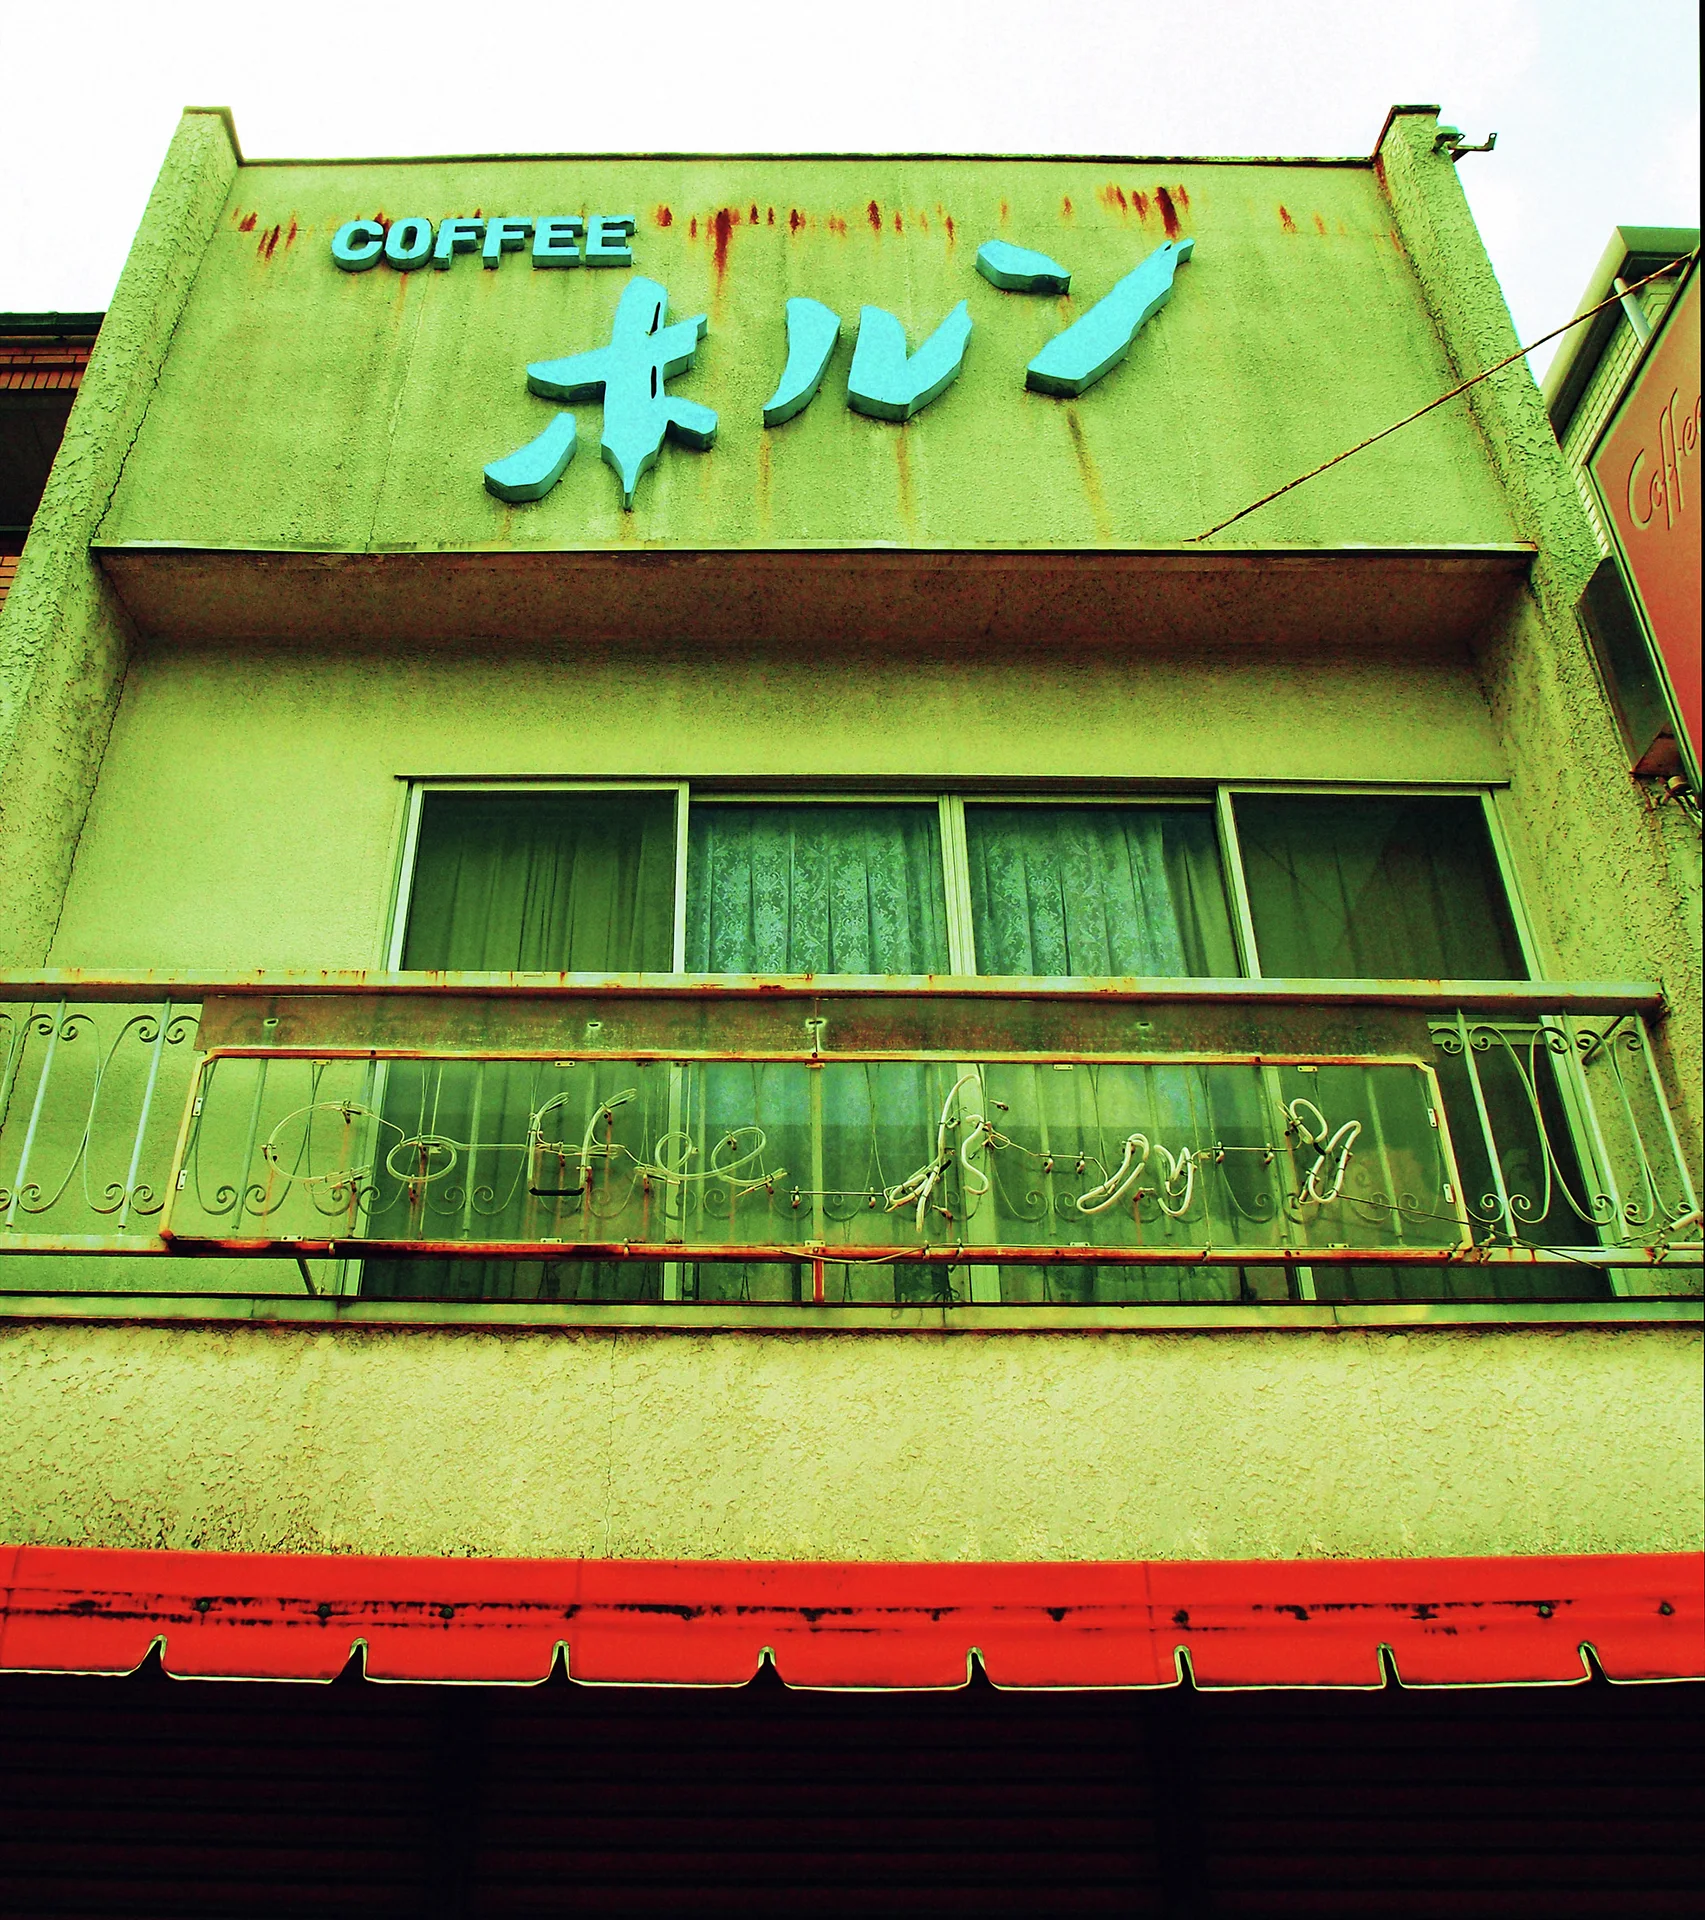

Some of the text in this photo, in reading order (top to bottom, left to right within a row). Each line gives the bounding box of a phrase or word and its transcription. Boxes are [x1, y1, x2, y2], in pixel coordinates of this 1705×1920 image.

[331, 216, 636, 271] COFFEE
[485, 238, 1194, 510] ホルン
[266, 1088, 788, 1199] Coffee
